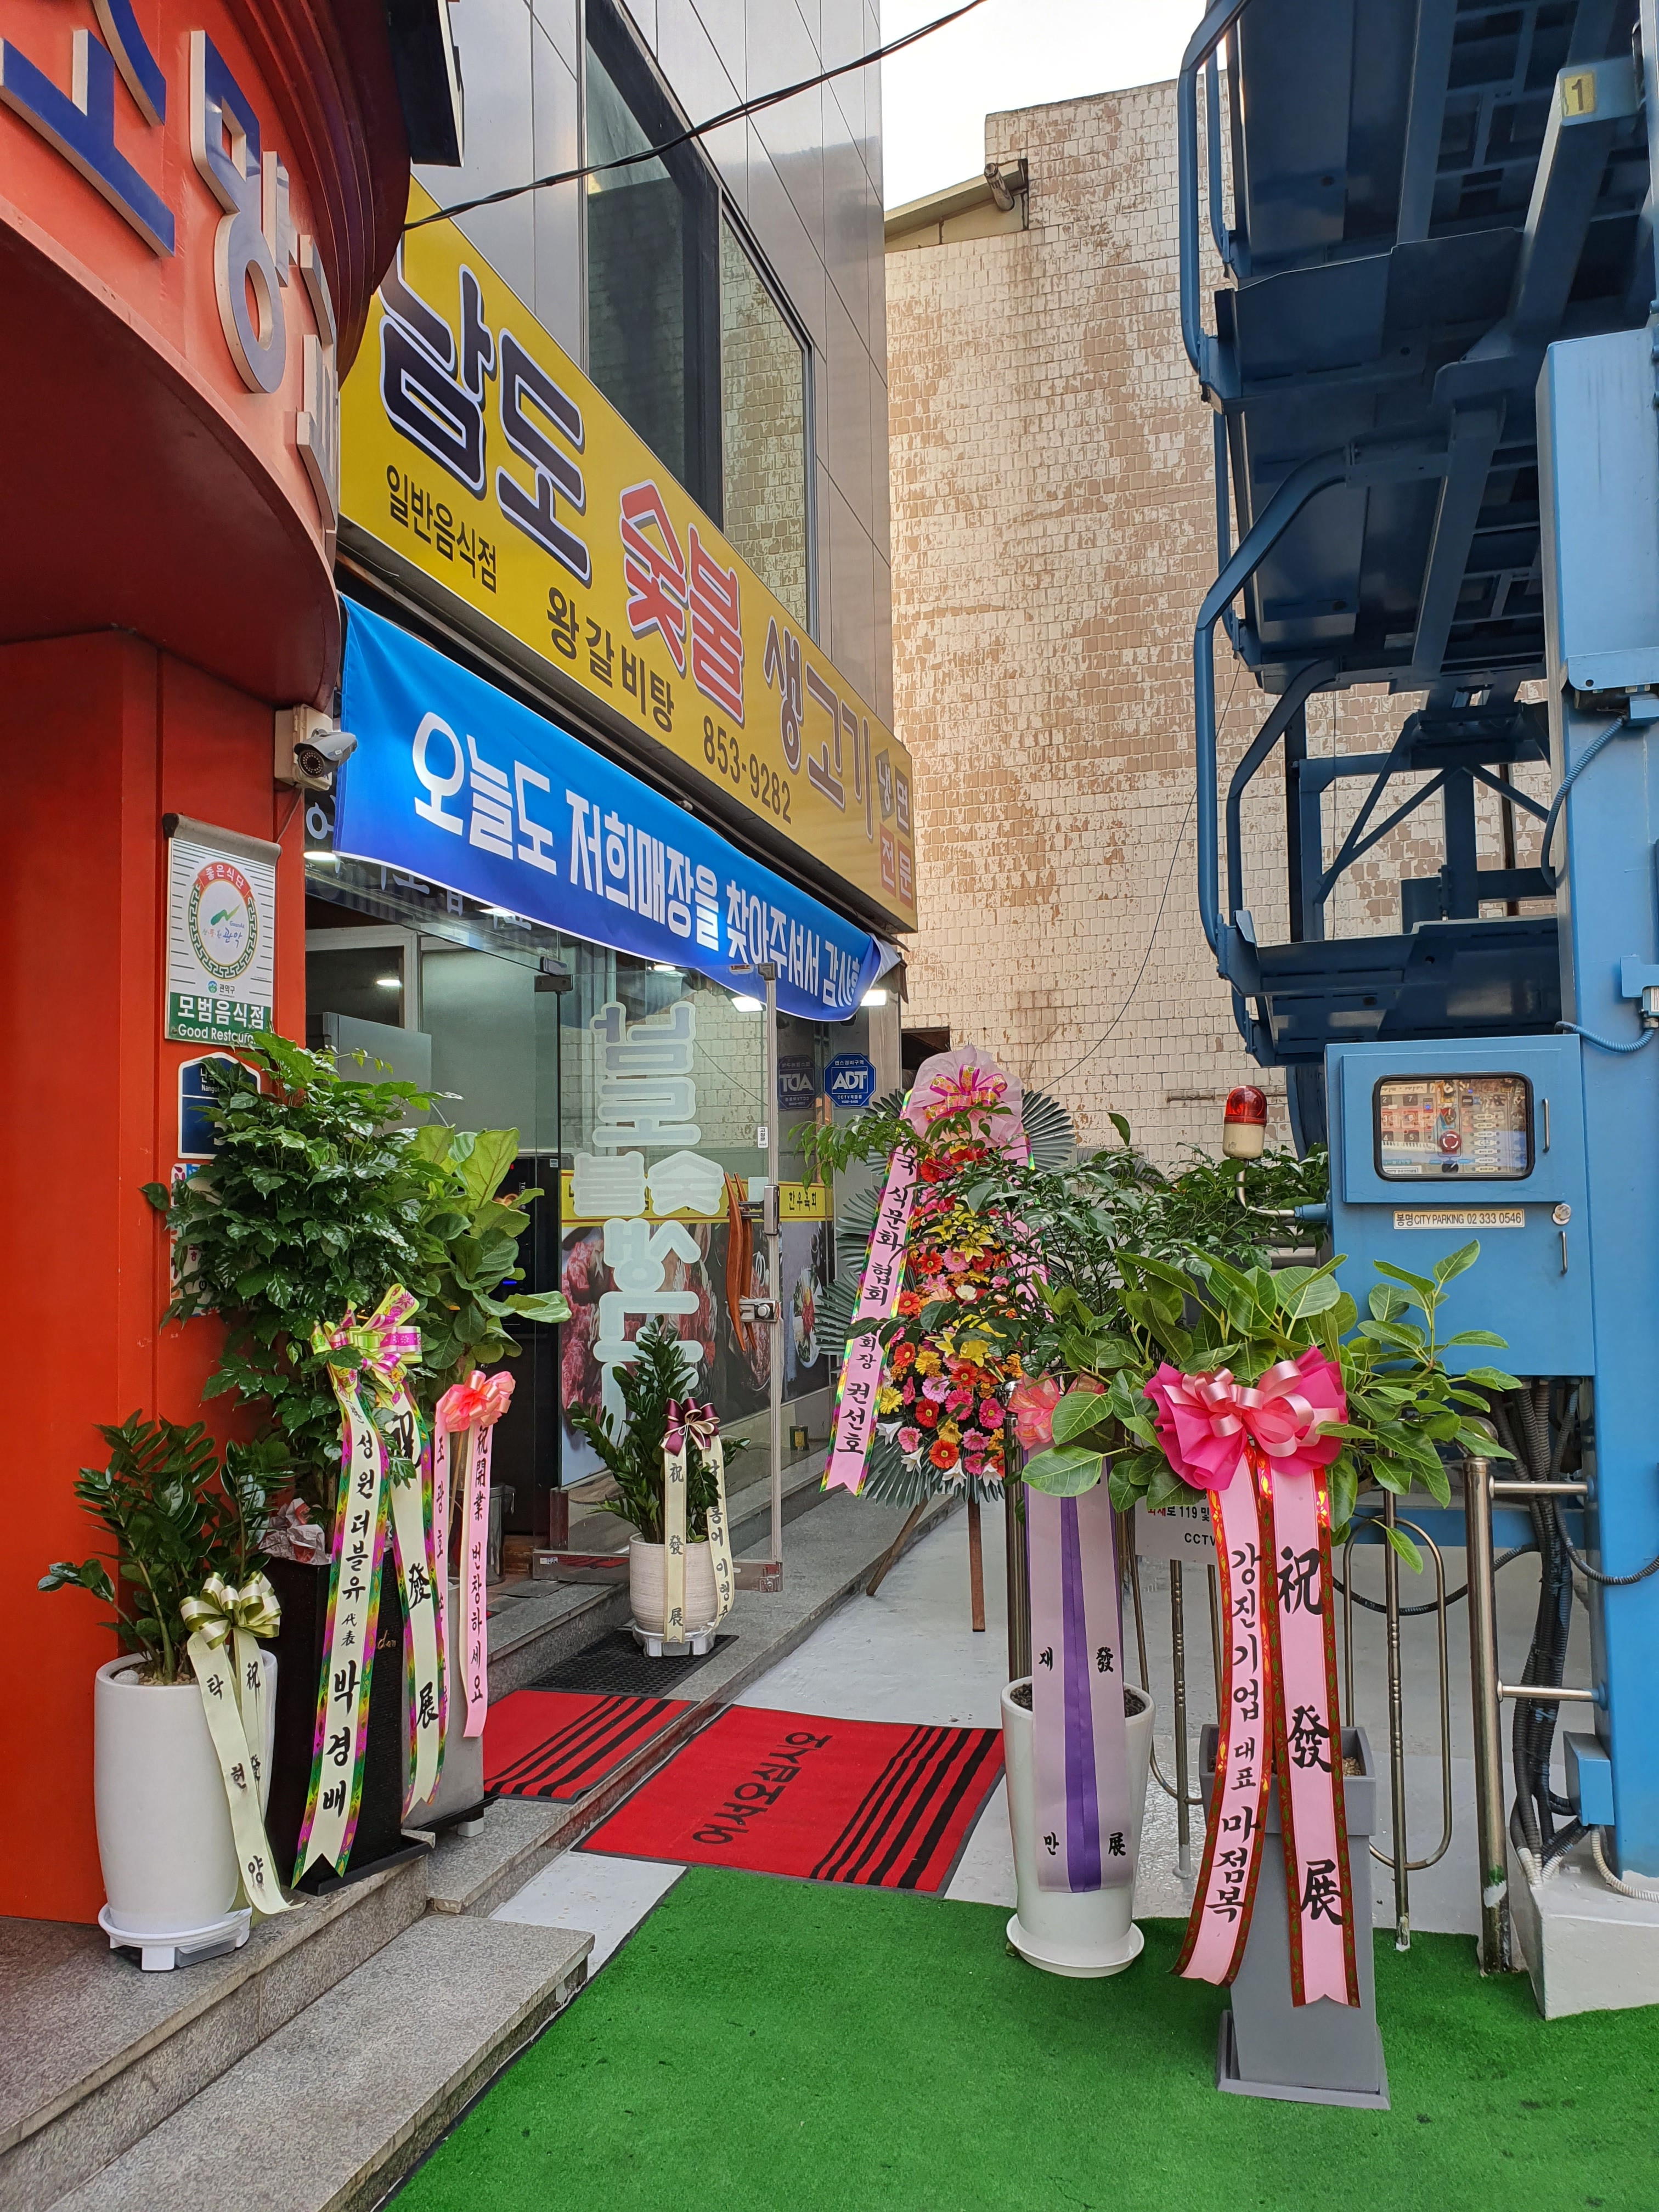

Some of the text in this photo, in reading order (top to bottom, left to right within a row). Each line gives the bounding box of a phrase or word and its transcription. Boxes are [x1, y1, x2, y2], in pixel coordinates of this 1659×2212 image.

[1570, 78, 1584, 111] 1
[386, 465, 496, 594] 일반음식점
[619, 479, 745, 729] 숯불
[765, 615, 874, 843] 생고기
[546, 587, 792, 825] 왕갈비탕 853-9282
[411, 712, 557, 876] 오늘도
[566, 789, 719, 952] 저희매장을
[726, 879, 820, 997] 찾아주셔서
[178, 996, 264, 1030] 모범음식점
[219, 984, 235, 994] 관악구
[178, 1023, 208, 1039] Good
[832, 1071, 867, 1089] ADT
[1414, 1214, 1431, 1224] CITY
[1432, 1214, 1464, 1224] PARKING
[1467, 1213, 1477, 1224] 02
[1479, 1212, 1497, 1224] 333
[1499, 1212, 1522, 1223] 0546
[836, 1381, 871, 1455] 권선호
[1180, 1505, 1198, 1519] 119
[1184, 1532, 1215, 1546] CCTV
[470, 1542, 483, 1703] 번창하세요
[1231, 1541, 1262, 1722] 강진기업
[323, 1660, 360, 1819] 박경배
[1231, 1736, 1257, 1792] 대표
[692, 1731, 833, 1844] 어서오십시오
